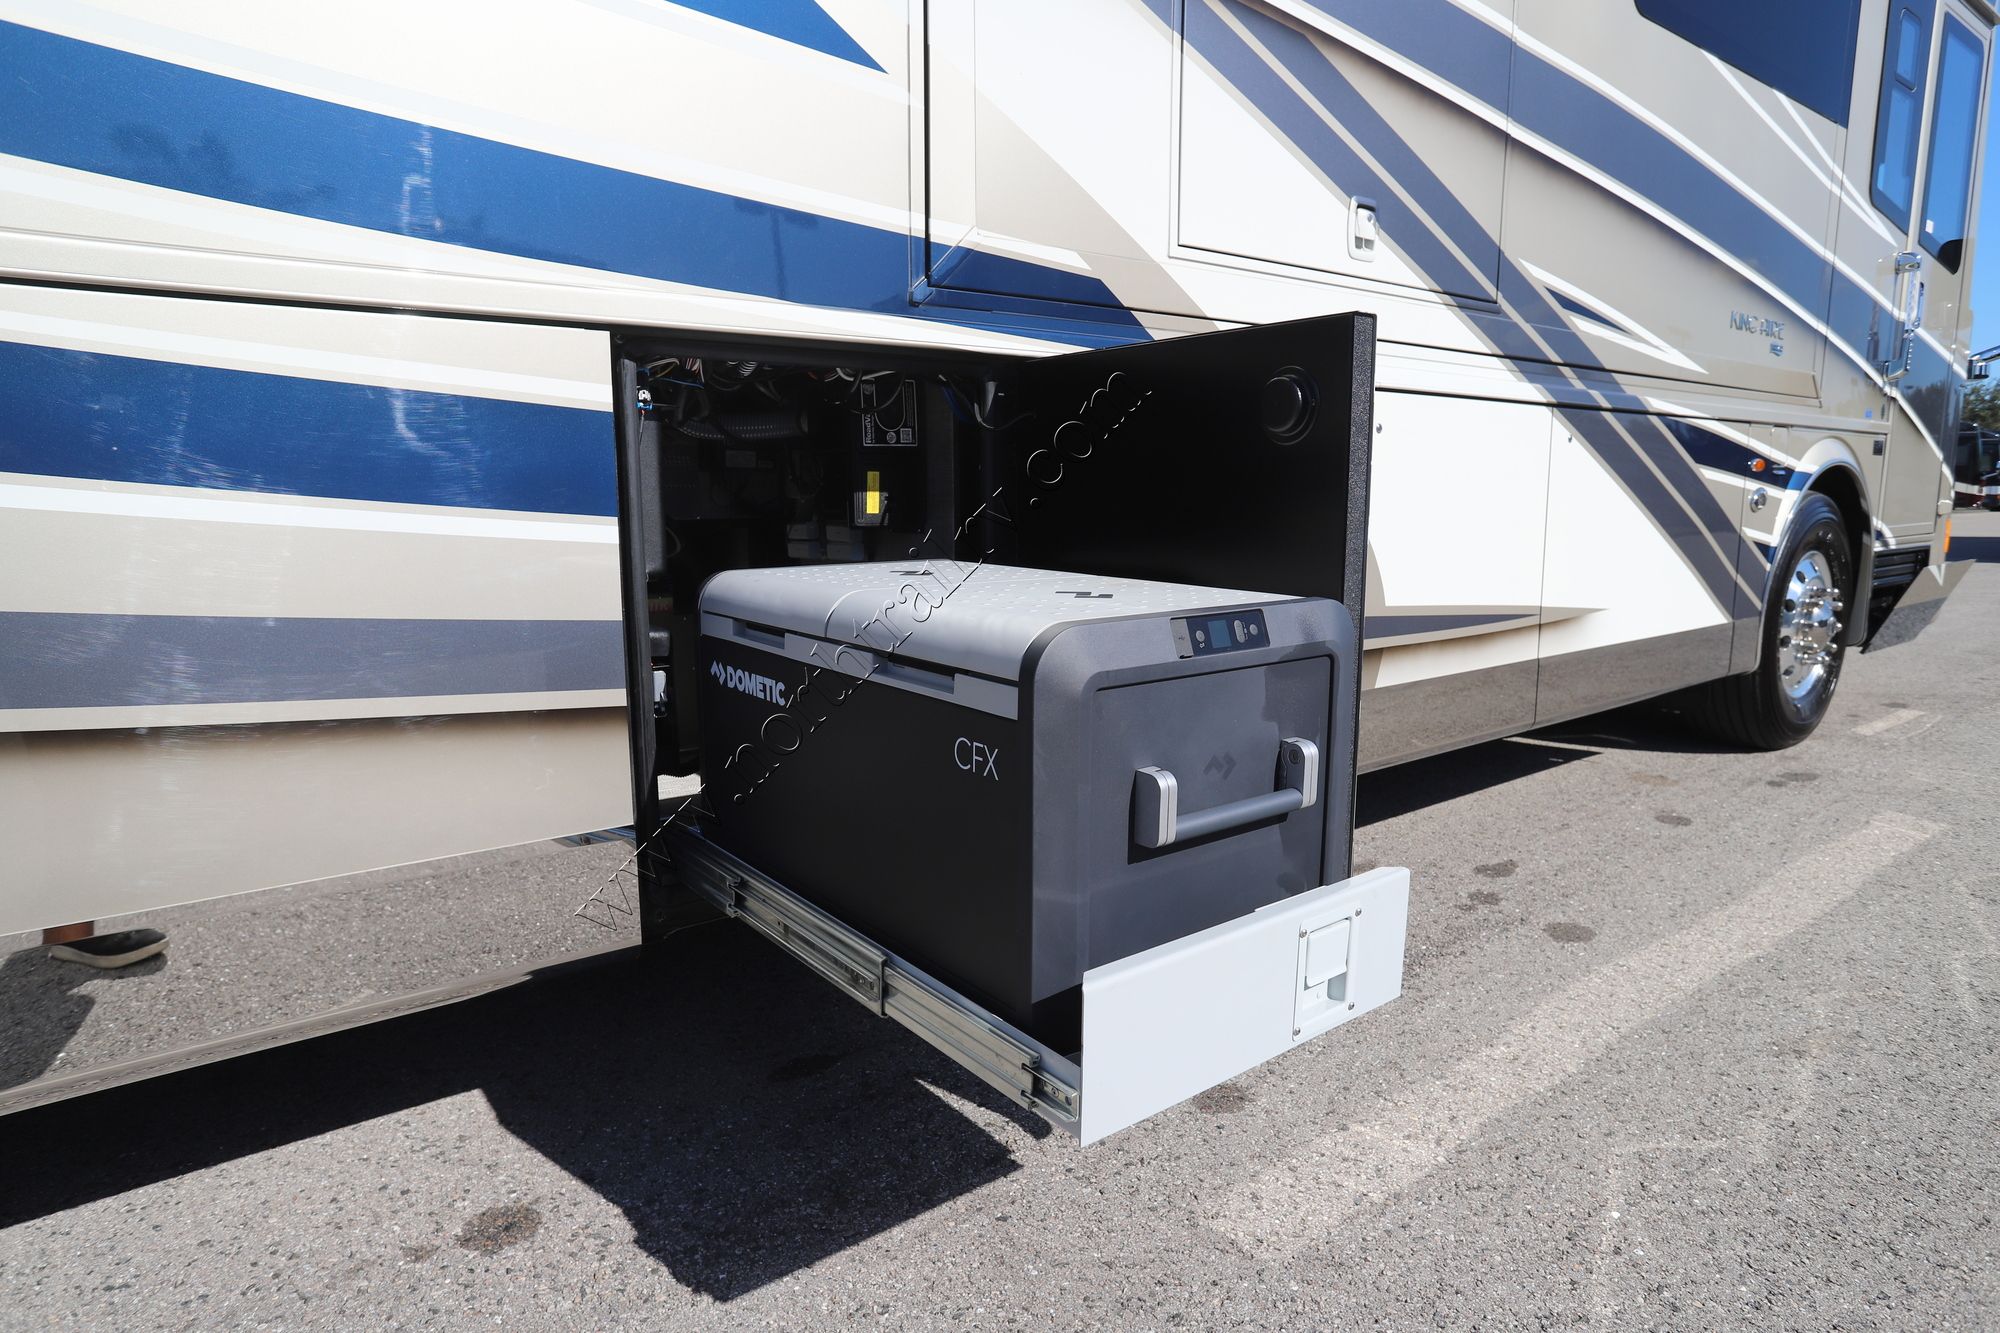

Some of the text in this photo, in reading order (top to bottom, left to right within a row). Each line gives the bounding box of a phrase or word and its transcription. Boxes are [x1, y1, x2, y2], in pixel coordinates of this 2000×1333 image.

[1730, 310, 1759, 334] KING
[726, 665, 786, 706] DOMETIC
[954, 737, 999, 781] CFX
